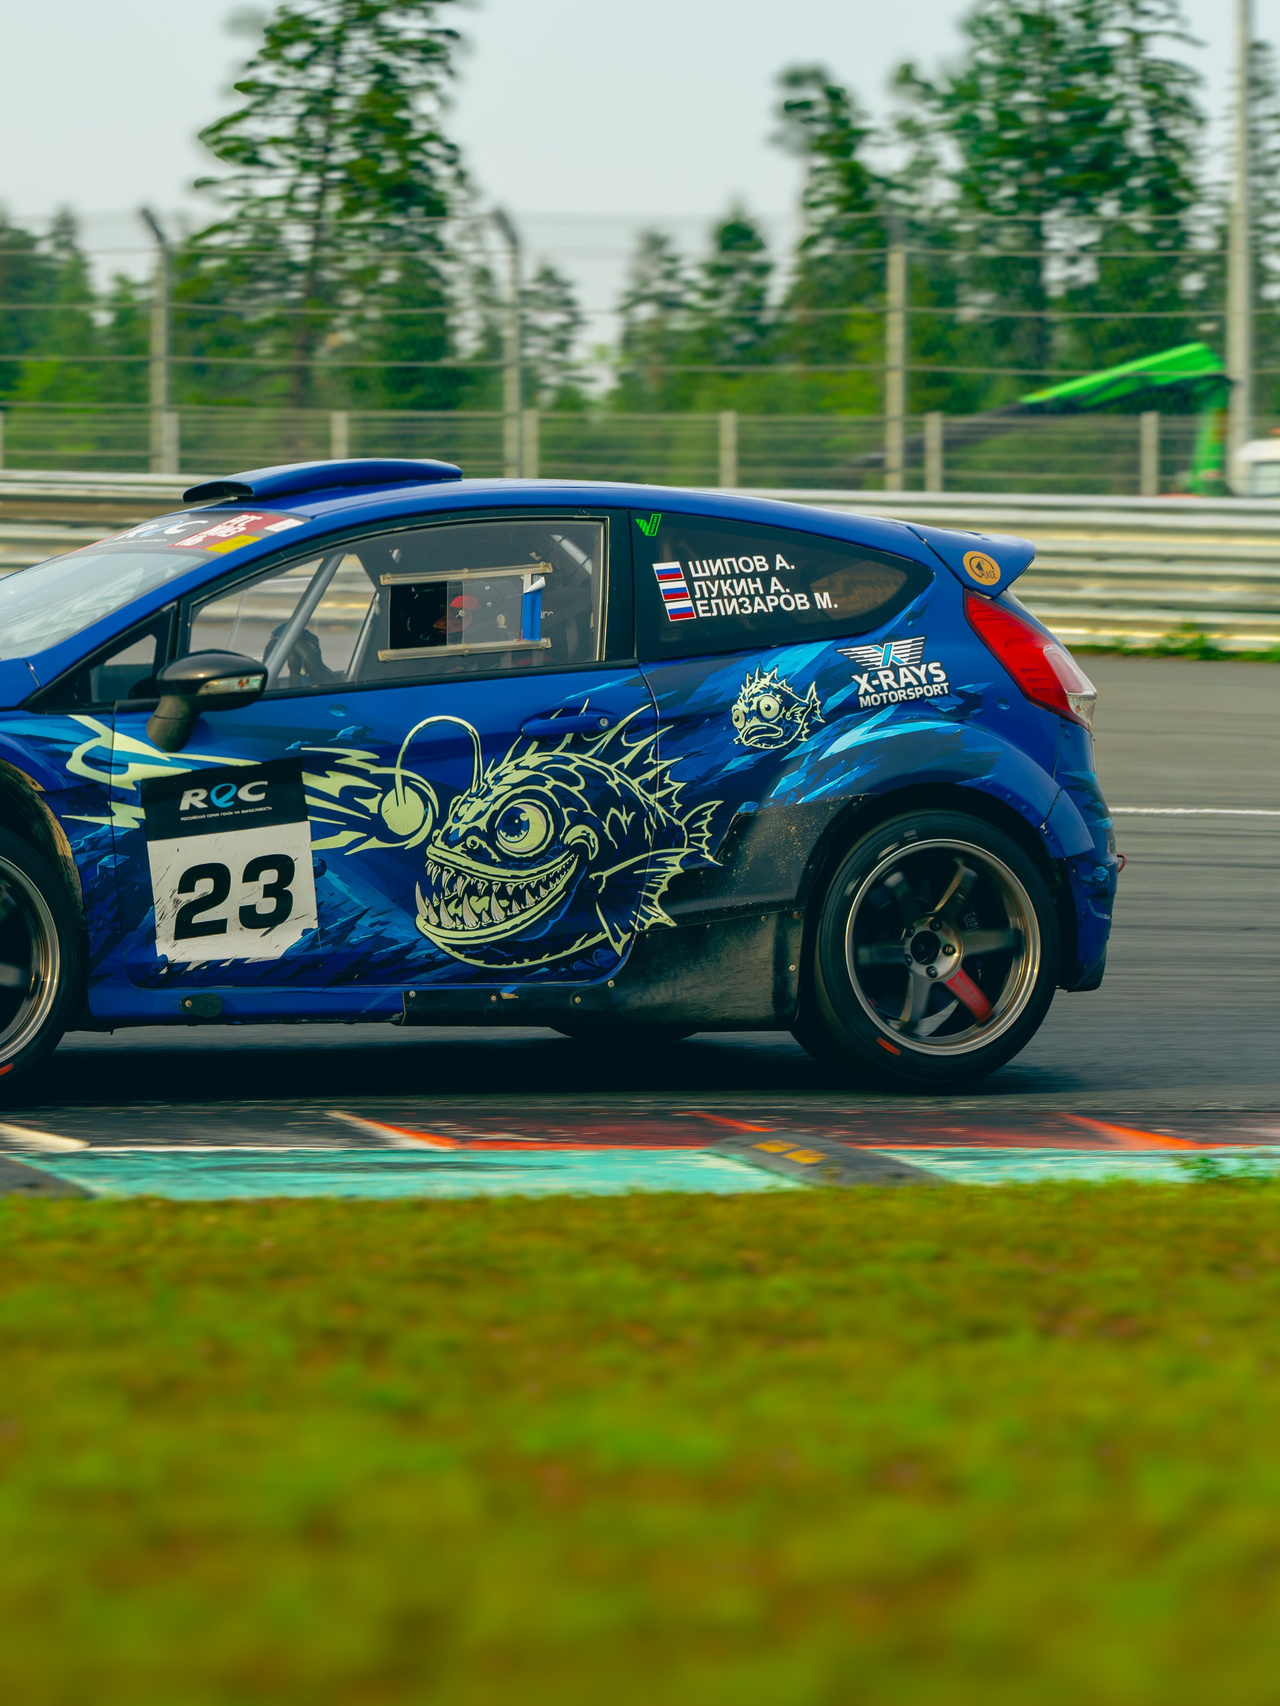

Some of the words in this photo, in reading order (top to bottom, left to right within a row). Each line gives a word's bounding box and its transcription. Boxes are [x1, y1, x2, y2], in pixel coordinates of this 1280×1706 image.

[688, 555, 769, 578] ШИПОВ
[775, 553, 795, 571] А.
[693, 577, 764, 599] ЛУКИН
[770, 576, 791, 594] А.
[695, 592, 811, 618] ЕЛИЗАРОВ
[814, 591, 839, 610] М.
[851, 662, 947, 695] X-RAYS
[859, 682, 950, 709] MOTORSPORT
[174, 854, 296, 940] 23
